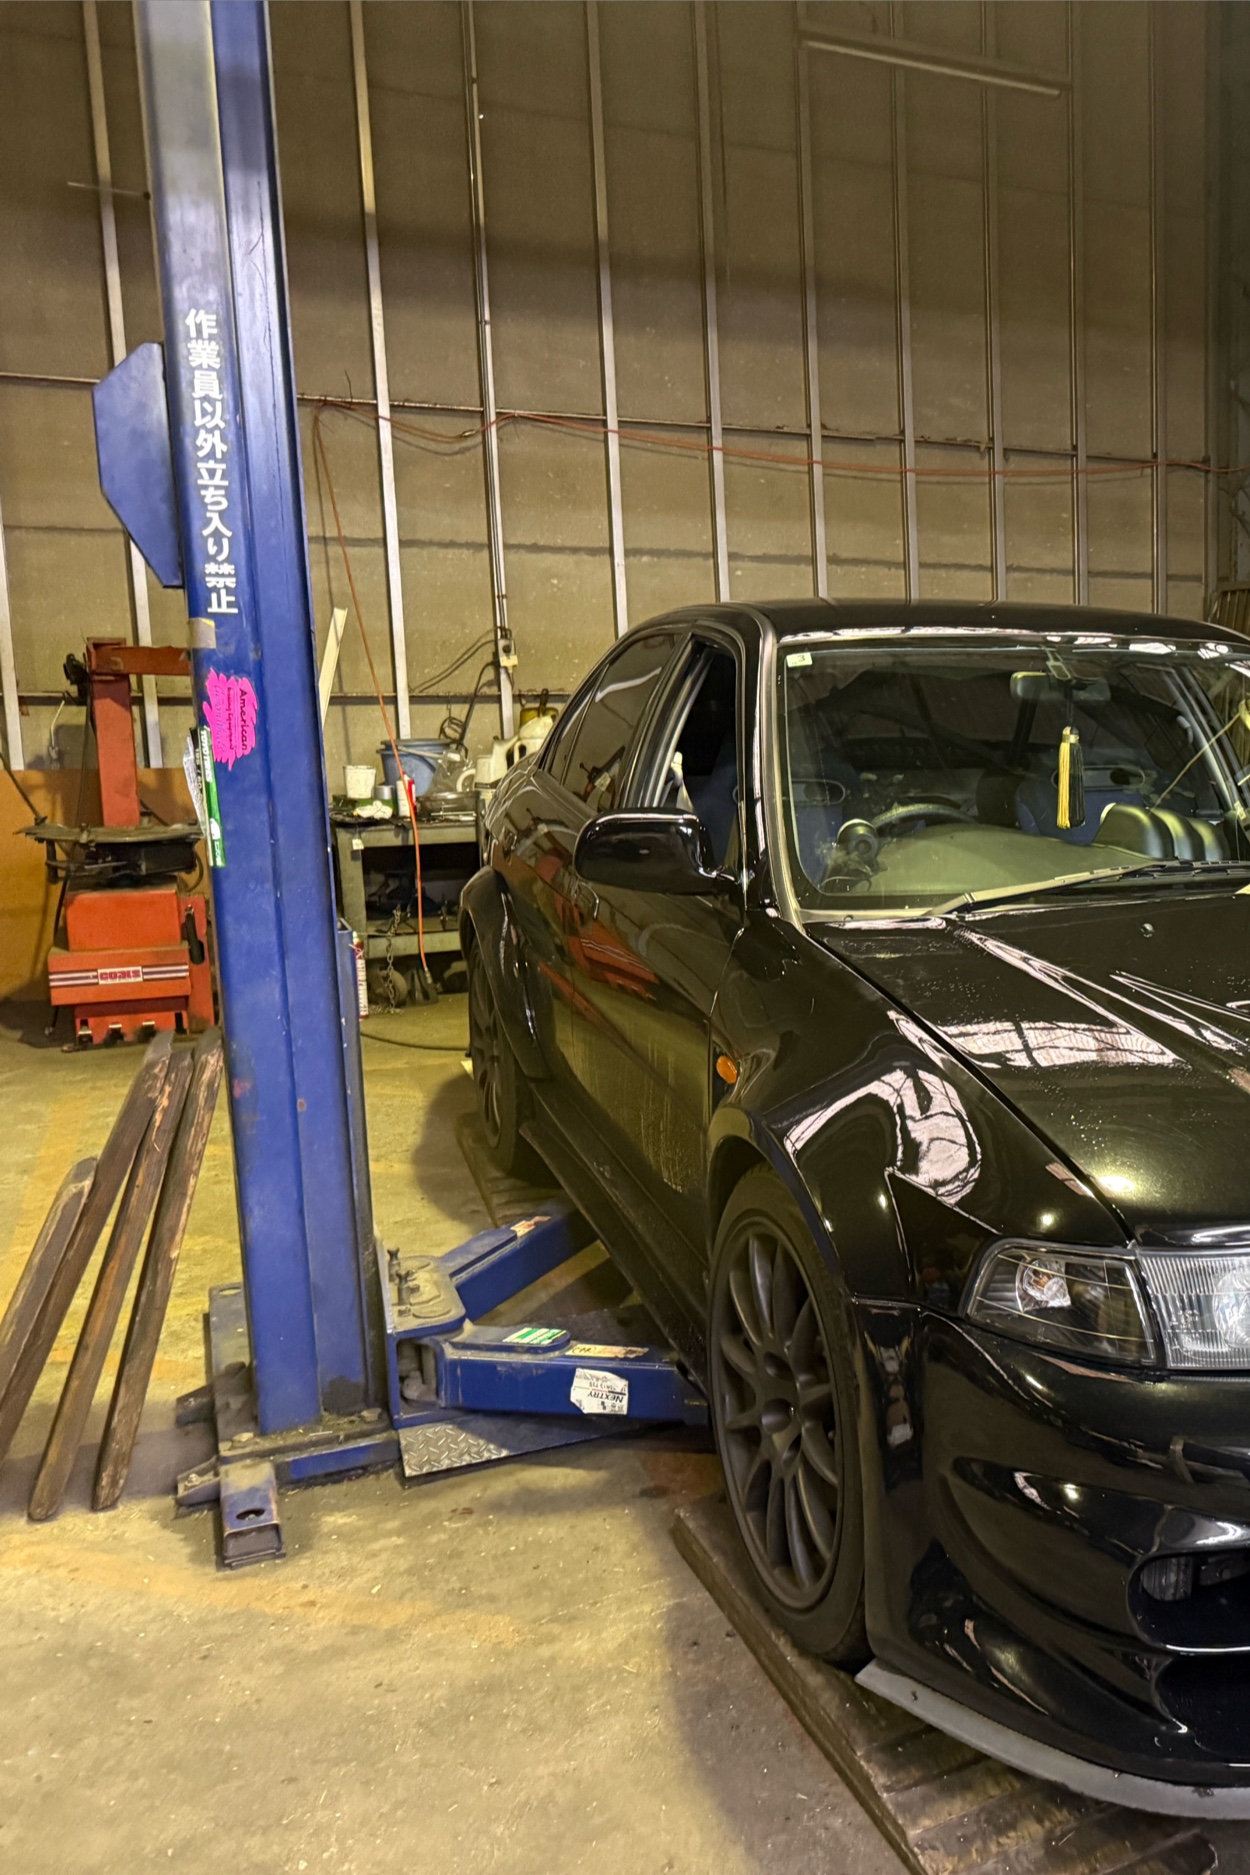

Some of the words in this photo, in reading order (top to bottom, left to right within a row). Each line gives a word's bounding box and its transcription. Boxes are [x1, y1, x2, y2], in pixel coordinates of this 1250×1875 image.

[185, 308, 239, 614] 作業員以外立ち入り禁止
[239, 688, 249, 750] American
[587, 1391, 624, 1403] NEXTRY
